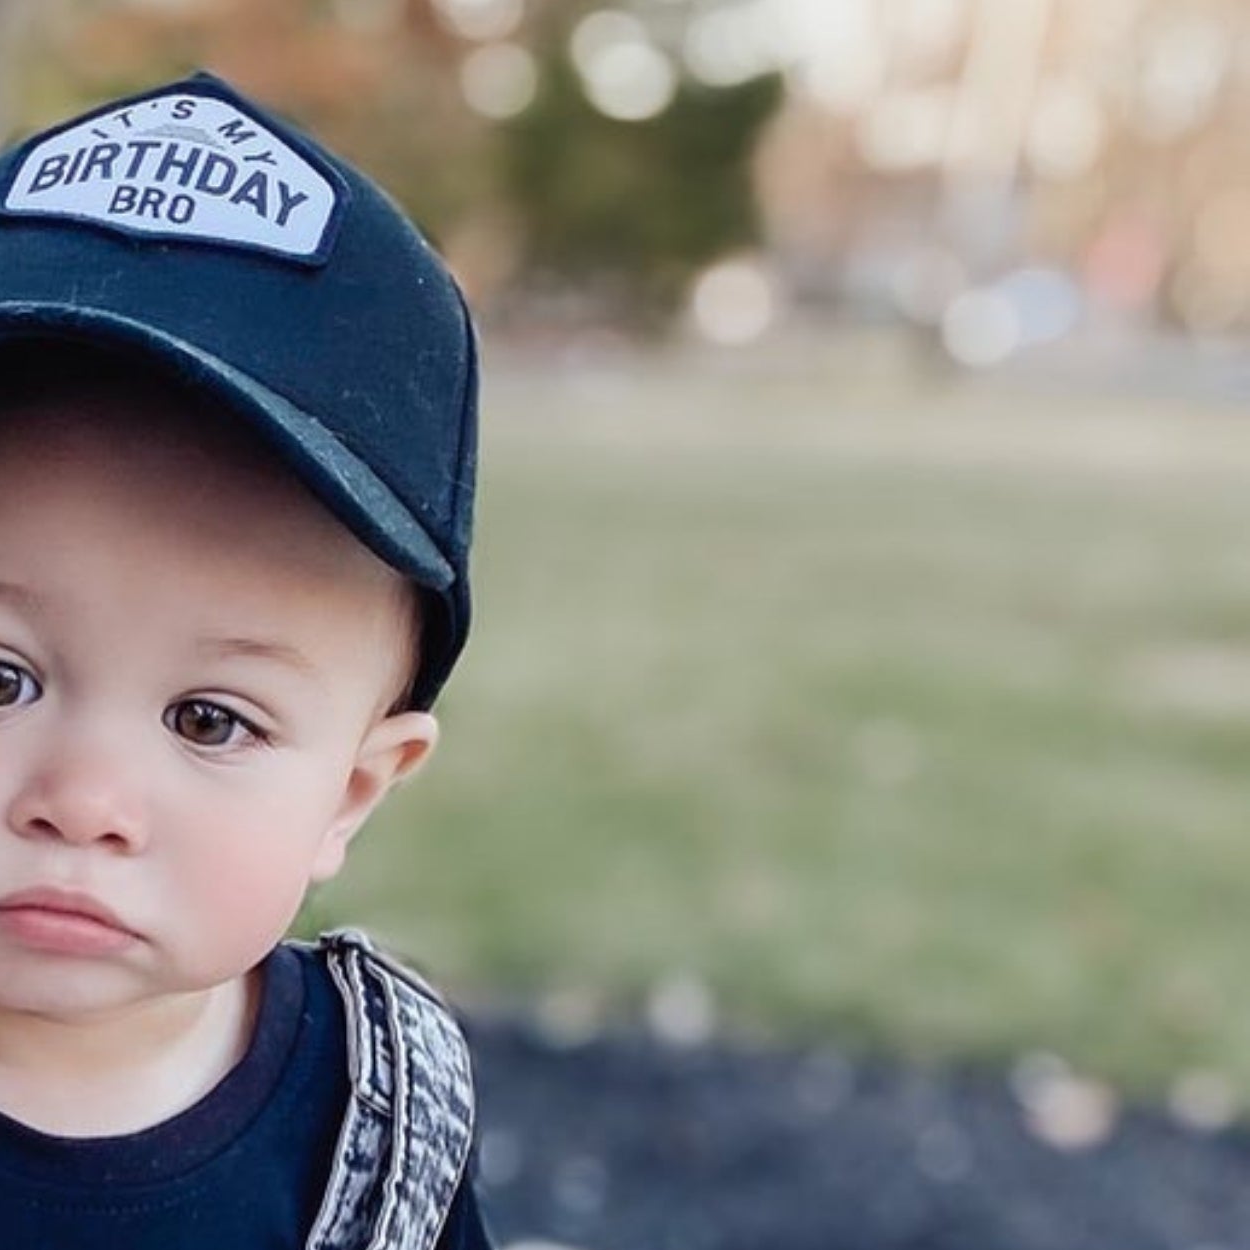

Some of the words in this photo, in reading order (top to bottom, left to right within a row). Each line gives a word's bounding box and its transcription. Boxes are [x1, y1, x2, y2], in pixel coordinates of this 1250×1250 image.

[91, 99, 197, 139] IT'S
[217, 118, 278, 166] MY
[27, 141, 309, 228] BIRTHDAY
[108, 185, 196, 224] BRO
